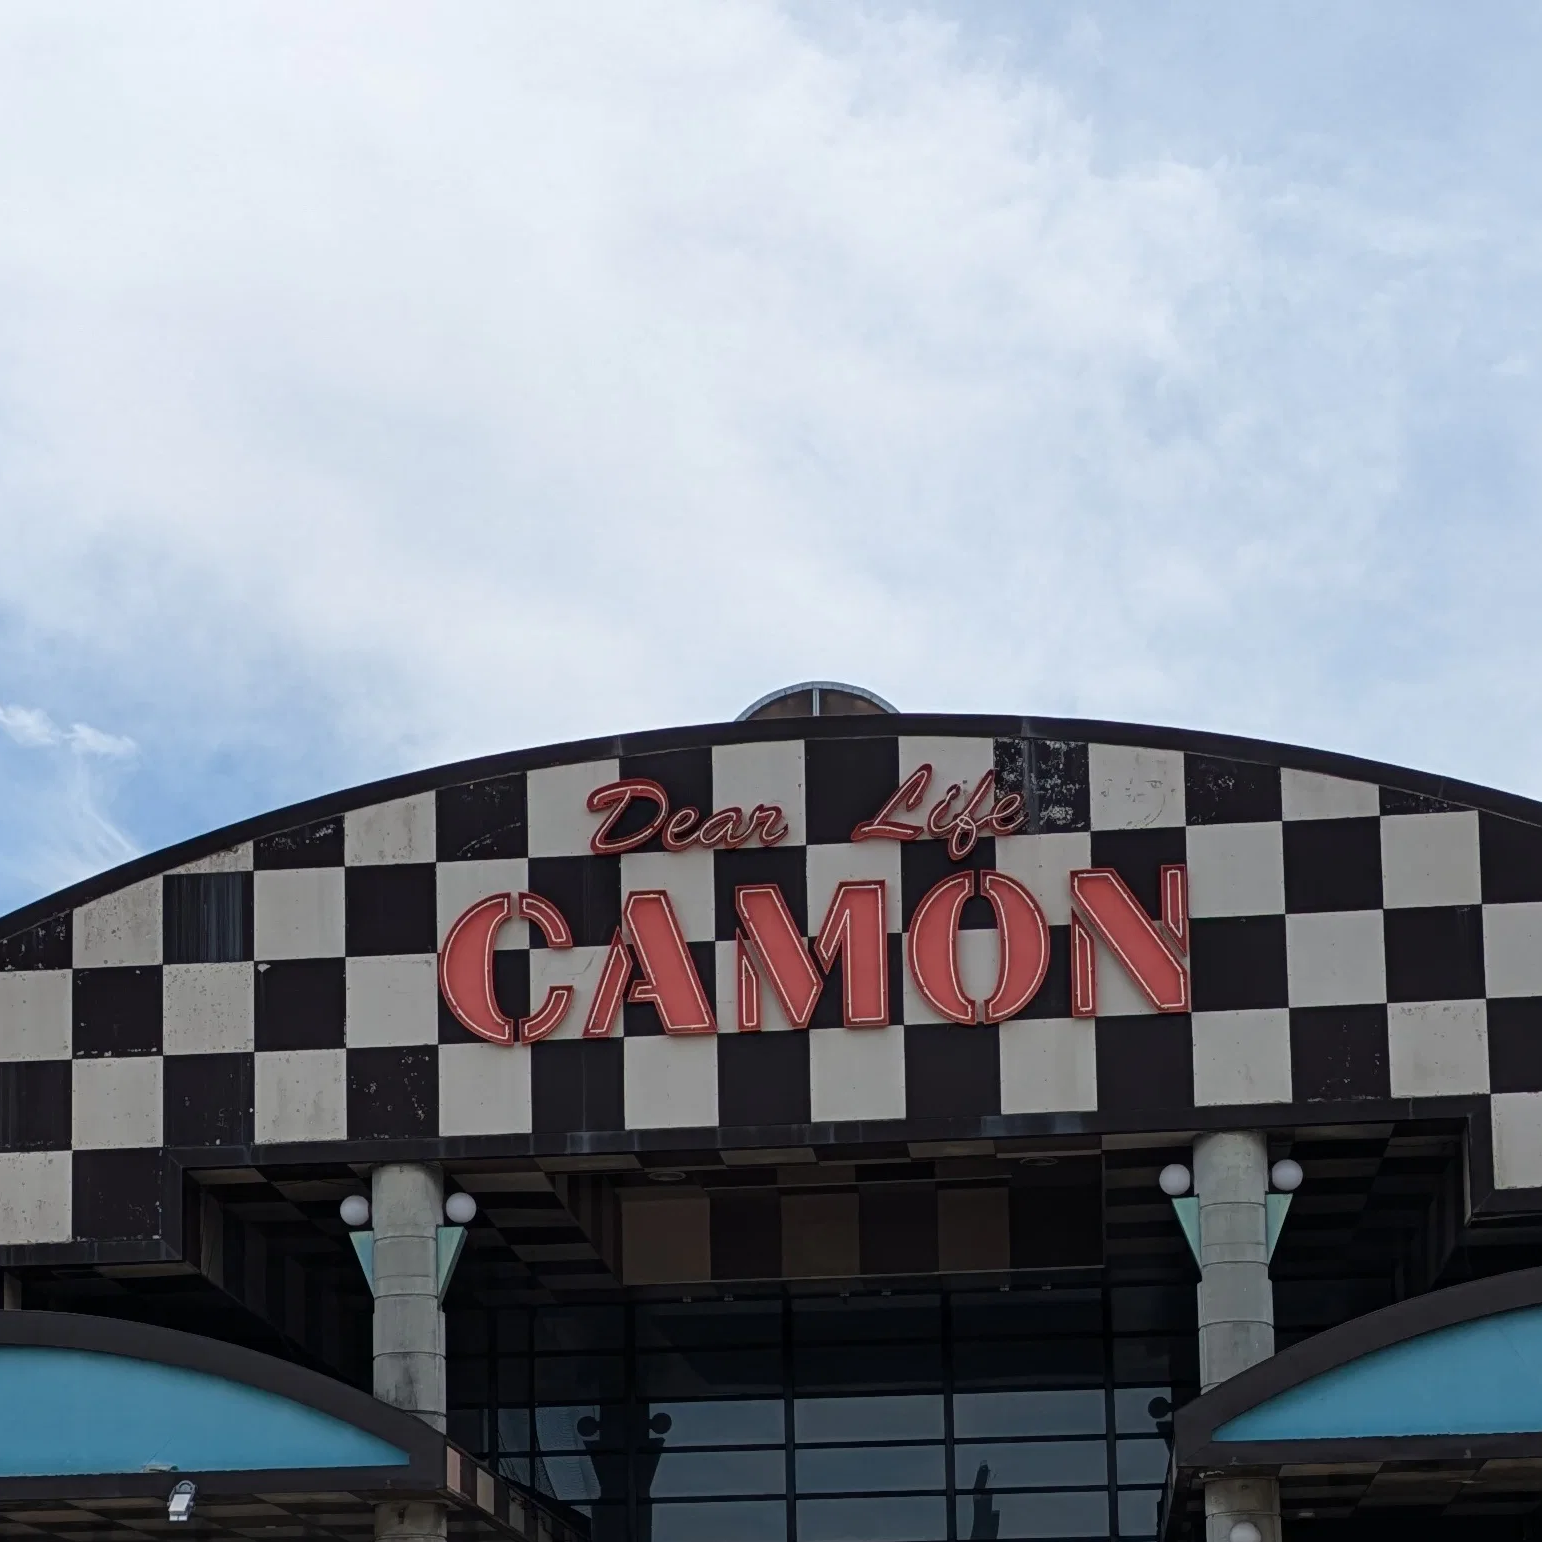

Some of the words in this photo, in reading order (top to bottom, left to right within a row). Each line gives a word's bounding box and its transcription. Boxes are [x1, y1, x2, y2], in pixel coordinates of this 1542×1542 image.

[587, 778, 789, 855] Dear
[851, 763, 1030, 861] Life
[440, 864, 1190, 1045] CAMON
